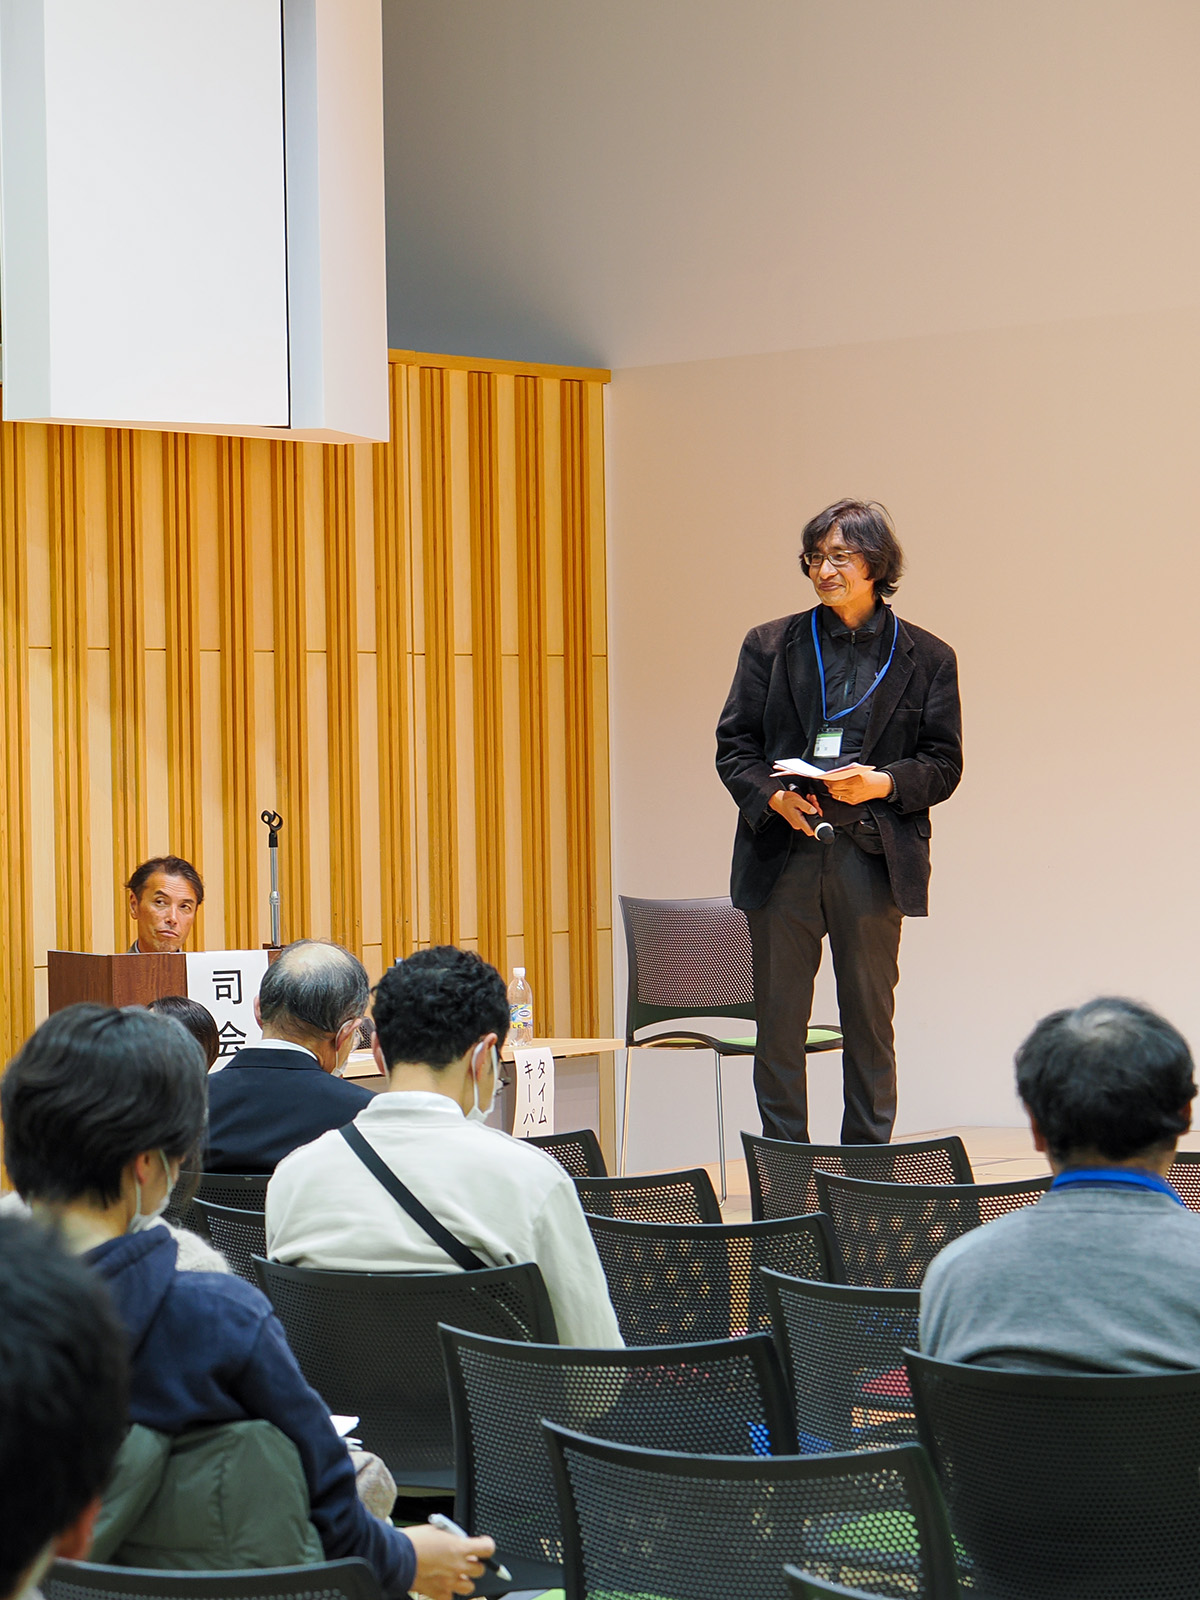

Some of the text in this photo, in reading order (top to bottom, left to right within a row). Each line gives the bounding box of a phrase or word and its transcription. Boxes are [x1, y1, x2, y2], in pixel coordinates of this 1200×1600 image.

[212, 969, 247, 1057] 司会
[523, 1060, 536, 1137] キーパ
[537, 1058, 548, 1125] タイム
